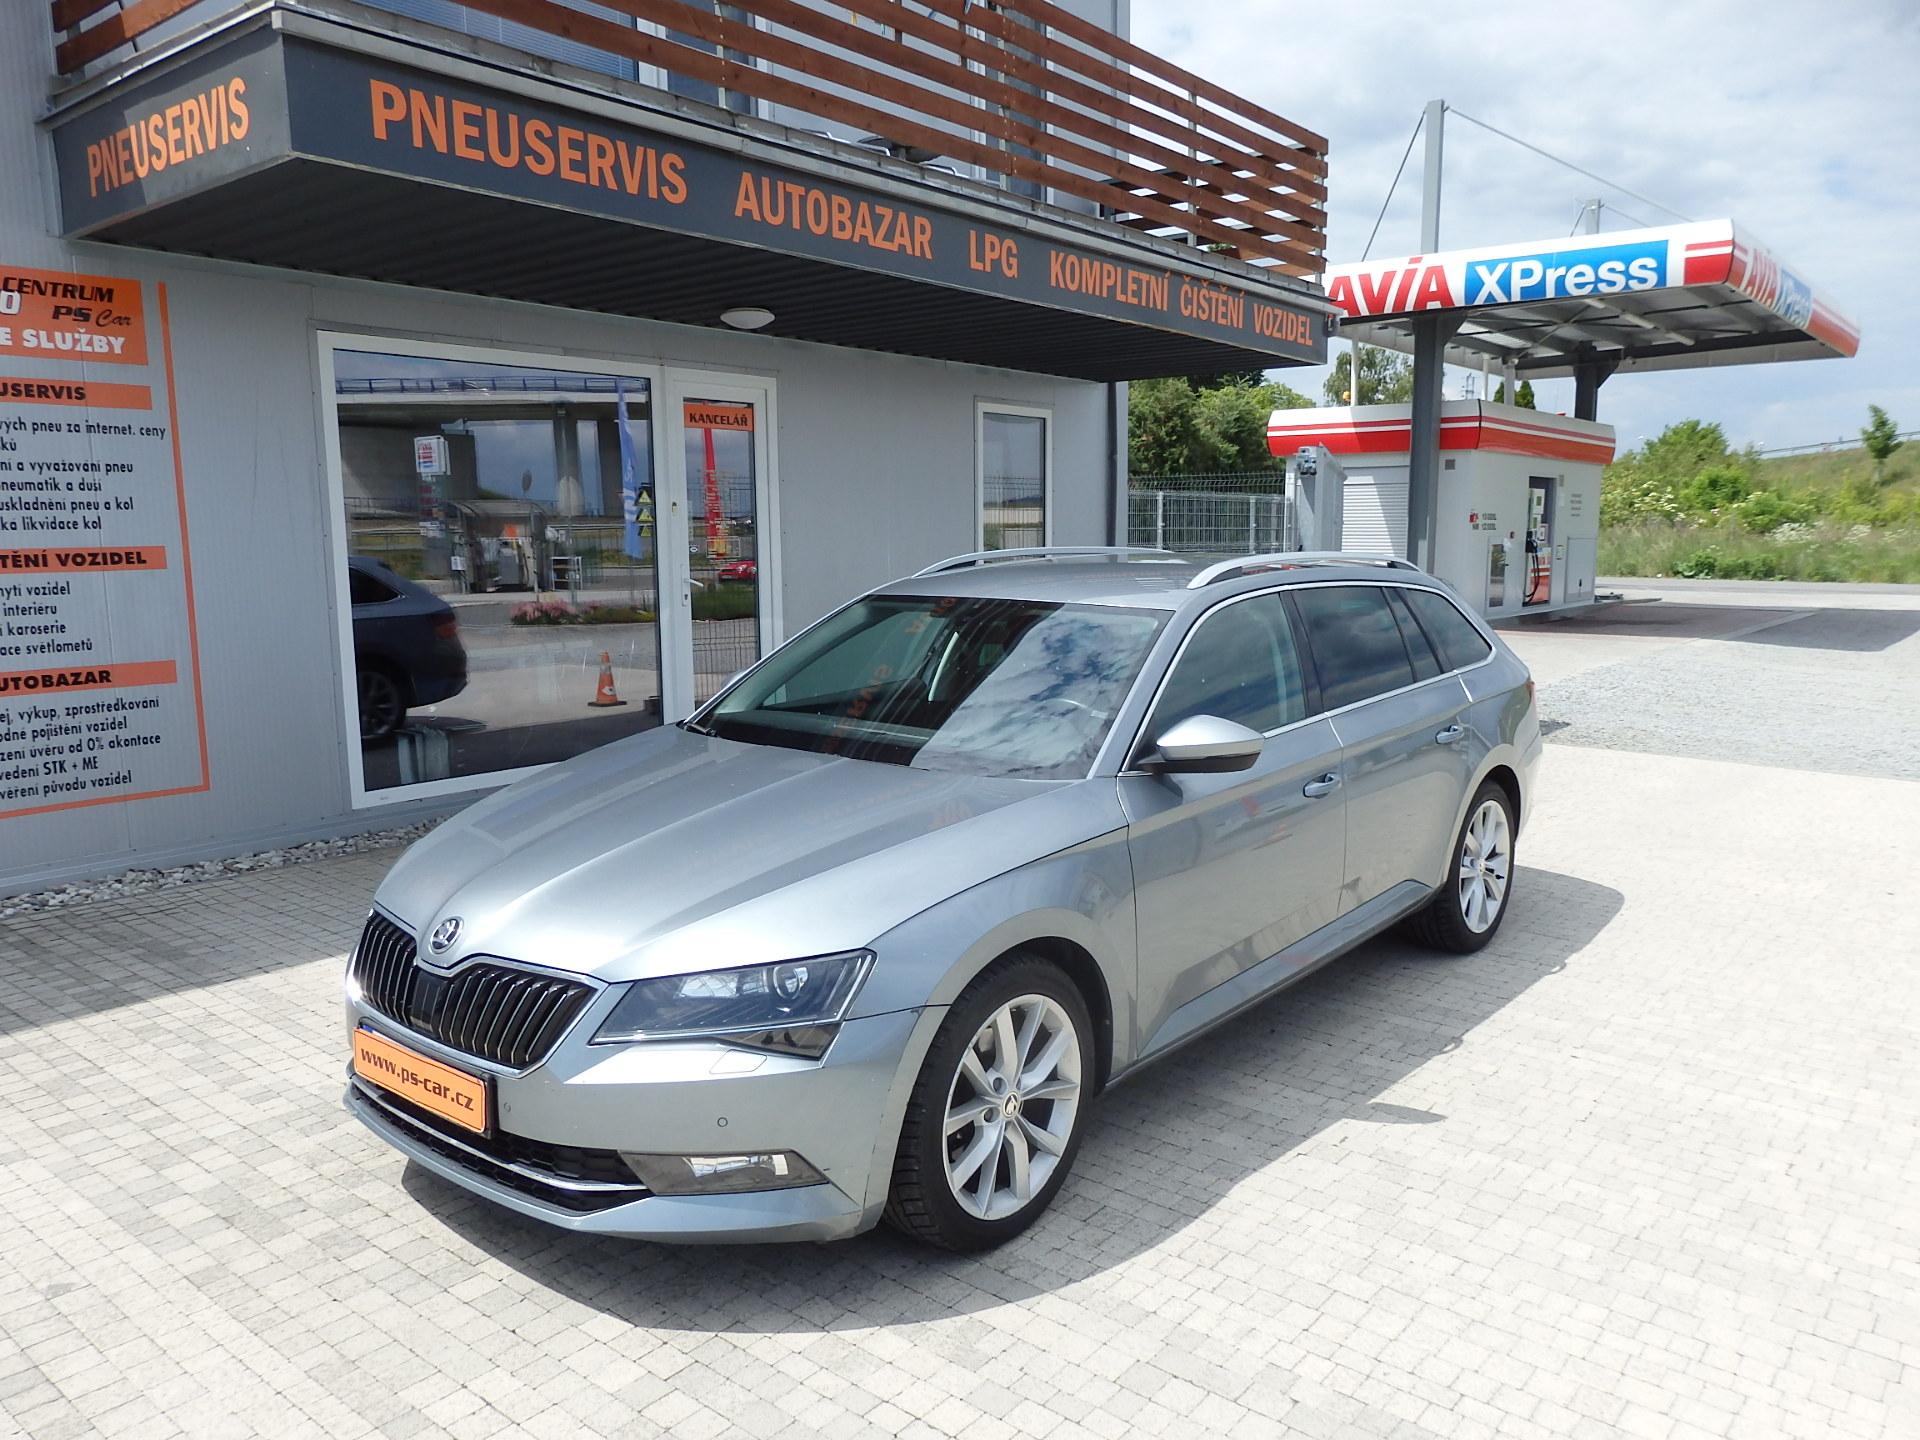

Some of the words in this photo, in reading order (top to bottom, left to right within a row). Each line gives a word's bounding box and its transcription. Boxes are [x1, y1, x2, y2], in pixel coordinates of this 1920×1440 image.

[87, 76, 250, 198] PNEUSERVIS
[369, 78, 688, 204] PNEUSERVIS
[734, 171, 933, 260] AUTOBAZAR
[968, 230, 1018, 279] LPG
[1050, 250, 1172, 312] KOMPLETNÍ
[1180, 275, 1245, 329] ČIŠTĚNÍ
[1253, 303, 1313, 346] VOZIDEL
[2, 277, 114, 303] CENTRUM
[1474, 257, 1658, 305] XPress
[52, 305, 93, 322] PS
[96, 309, 133, 327] Car
[22, 327, 125, 354] SLUŽBY
[32, 421, 62, 435] pneu
[67, 423, 81, 433] za
[85, 419, 136, 435] internet.
[140, 425, 166, 440] ceny
[689, 411, 748, 427] KANCELÁŘ
[17, 461, 24, 471] a
[30, 459, 101, 475] vyvažování
[105, 463, 133, 475] pneu
[0, 477, 61, 491] neumatik
[66, 482, 73, 491] a
[70, 501, 99, 514] pneu
[104, 501, 111, 511] a
[115, 496, 134, 511] kol
[22, 516, 79, 530] likvidace
[83, 515, 102, 530] kol
[55, 551, 147, 567] VOZIDEL
[26, 580, 70, 596] vozidel
[3, 601, 57, 616] interiéru
[7, 620, 66, 636] karoserie
[26, 638, 93, 654] světlometů
[18, 706, 60, 723] výkup,
[65, 696, 159, 719] zprostředkování
[32, 722, 81, 742] pojištění
[86, 715, 127, 732] vozidel
[30, 743, 64, 758] úvěru
[69, 738, 83, 753] od
[108, 734, 161, 748] akontace
[44, 759, 67, 775] STK
[72, 762, 78, 770] +
[83, 756, 98, 770] ME
[43, 776, 86, 797] původu
[91, 769, 132, 787] vozidel
[360, 1047, 474, 1112] www.ps-car.cz
